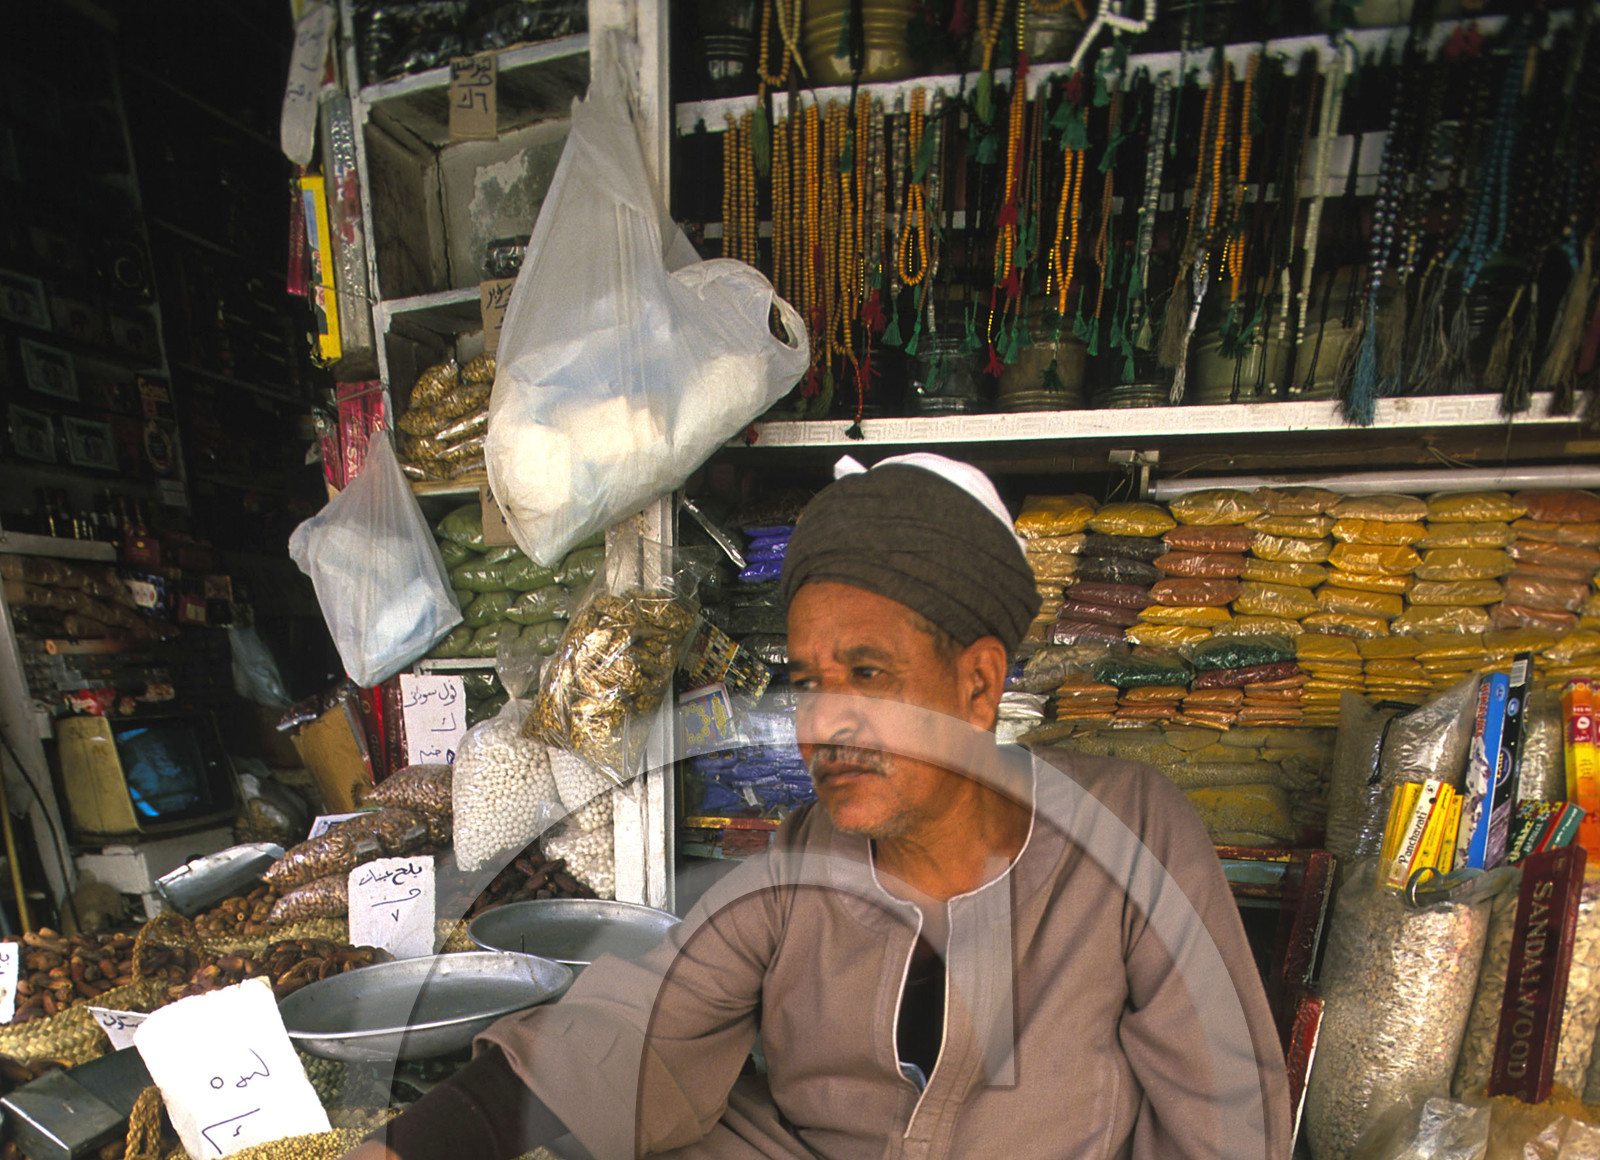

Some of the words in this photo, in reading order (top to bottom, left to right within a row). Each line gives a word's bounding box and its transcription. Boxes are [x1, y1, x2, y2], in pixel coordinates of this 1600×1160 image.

[1397, 809, 1428, 866] Panchavati
[391, 862, 423, 886] بلح
[1506, 880, 1555, 1079] SANDALWOOD
